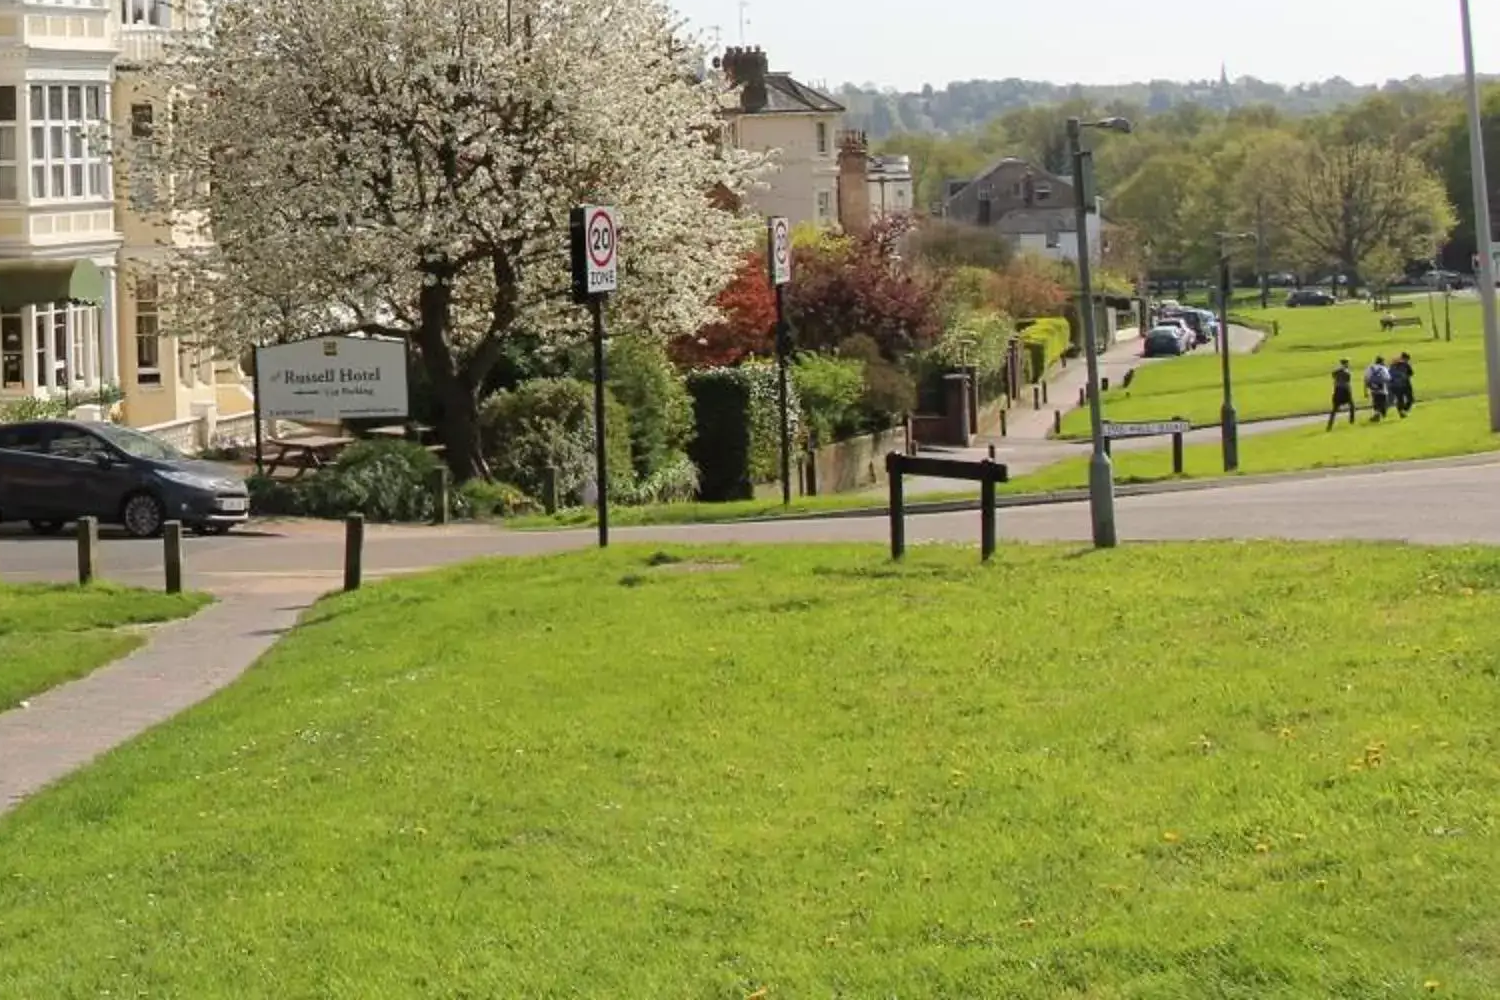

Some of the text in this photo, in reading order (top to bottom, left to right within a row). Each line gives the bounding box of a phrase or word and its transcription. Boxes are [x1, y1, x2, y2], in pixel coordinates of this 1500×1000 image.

[592, 227, 610, 249] 20
[591, 270, 615, 285] ZONE
[284, 368, 335, 384] Russell
[339, 367, 381, 383] Hotel
